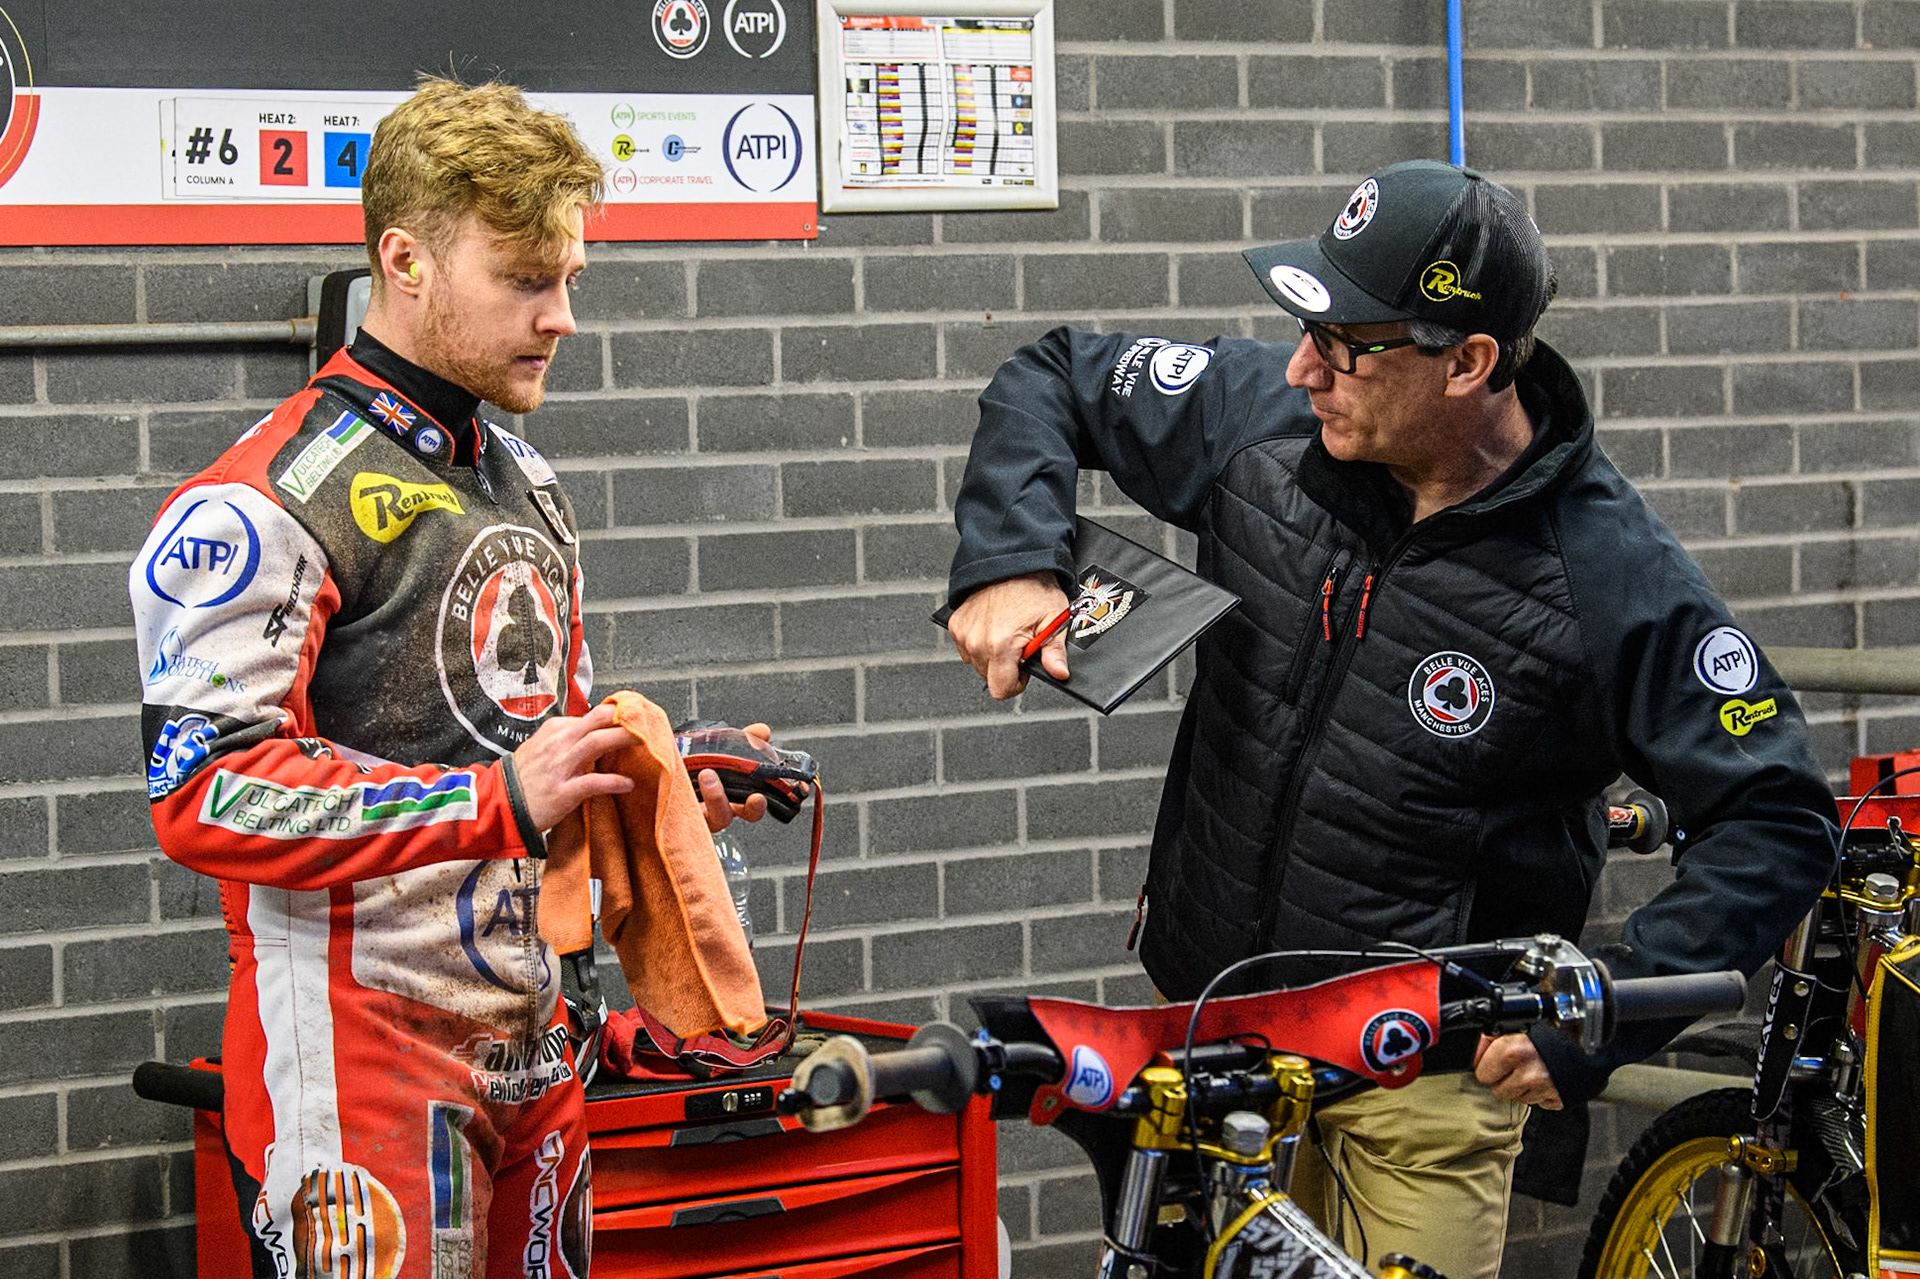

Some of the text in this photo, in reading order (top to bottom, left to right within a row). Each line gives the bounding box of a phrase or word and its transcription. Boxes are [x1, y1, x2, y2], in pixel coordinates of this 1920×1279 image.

[734, 13, 774, 33] ATPI
[259, 113, 296, 124] HEAT 2:
[324, 116, 360, 127] HEAT 7:
[637, 112, 666, 120] SPORTS
[668, 112, 696, 120] EVENTS
[185, 127, 238, 165] #6
[273, 138, 293, 175] 2
[337, 141, 357, 177] 4
[736, 135, 787, 159] ATPI
[186, 176, 225, 185] COLUMN
[639, 176, 684, 184] CORPORATE
[688, 176, 713, 184] TRAVEL
[1167, 348, 1197, 379] ATPI
[1121, 372, 1140, 397] VUE
[359, 484, 457, 531] Rentruck
[161, 536, 239, 575] ATPI
[452, 536, 566, 621] BELLE VUE ACES
[1713, 647, 1747, 676] ATPI
[1423, 657, 1490, 703] BELLE VUE ACES
[1414, 699, 1472, 733] MANCHESTER
[1724, 705, 1775, 731] Rentruck
[232, 809, 350, 834] BELTING LTD
